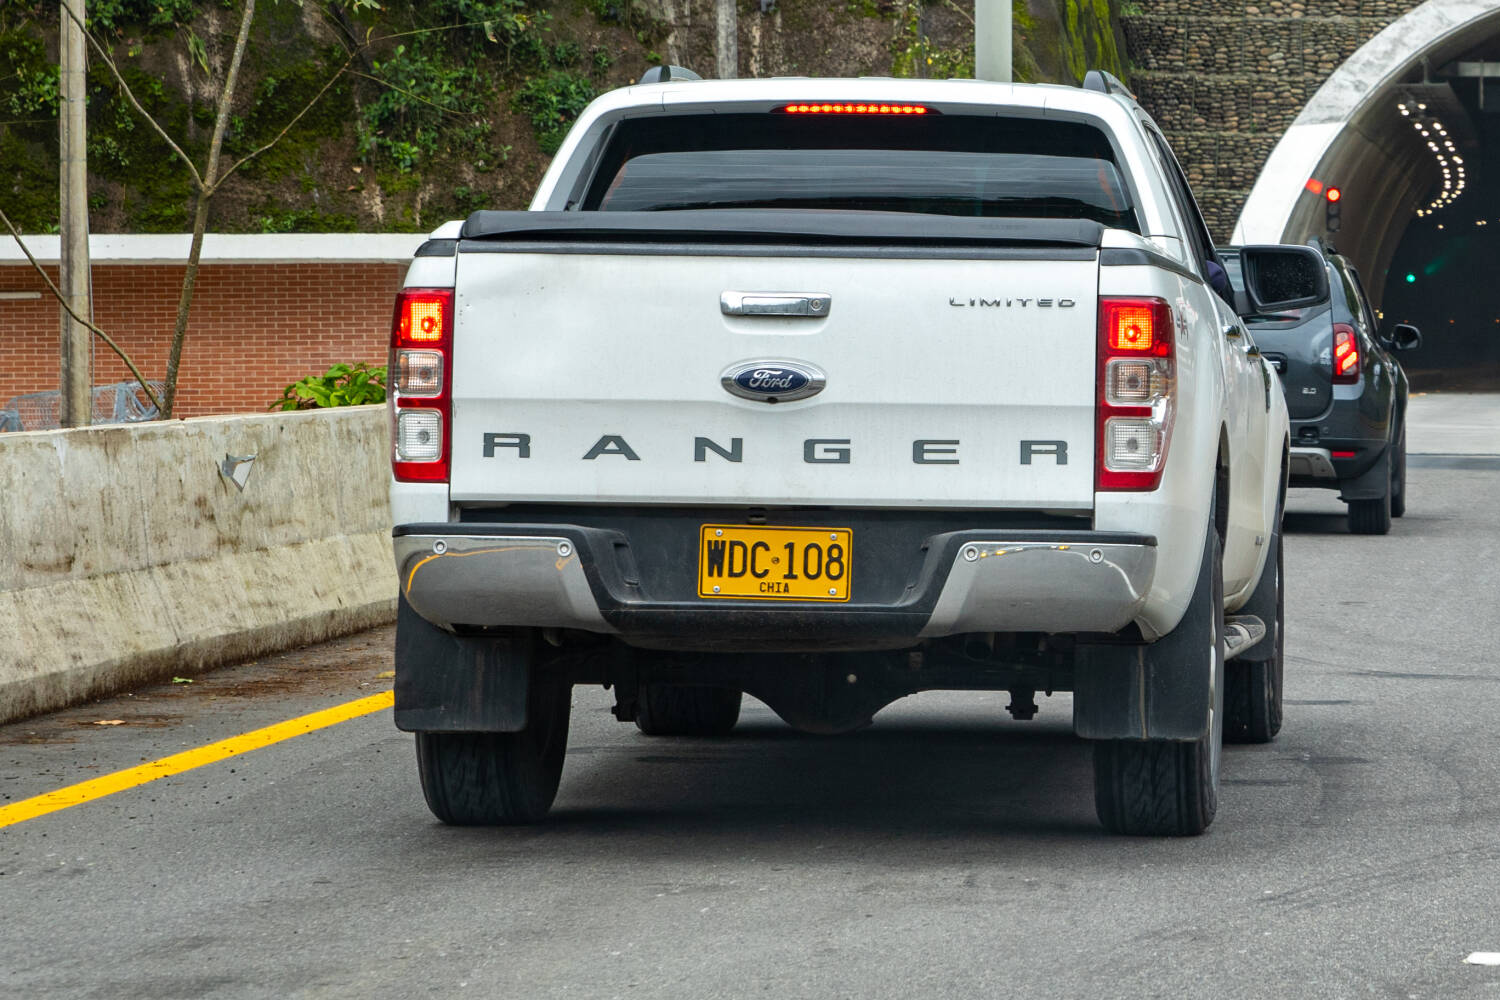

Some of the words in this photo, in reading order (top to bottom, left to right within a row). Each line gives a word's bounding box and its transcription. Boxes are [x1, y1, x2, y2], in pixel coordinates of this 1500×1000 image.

[949, 296, 1077, 308] LIMITED
[748, 370, 794, 390] Ford
[482, 432, 1069, 466] RANGER
[706, 539, 771, 579] WDC
[783, 541, 845, 581] 108
[759, 581, 790, 594] CHIA
